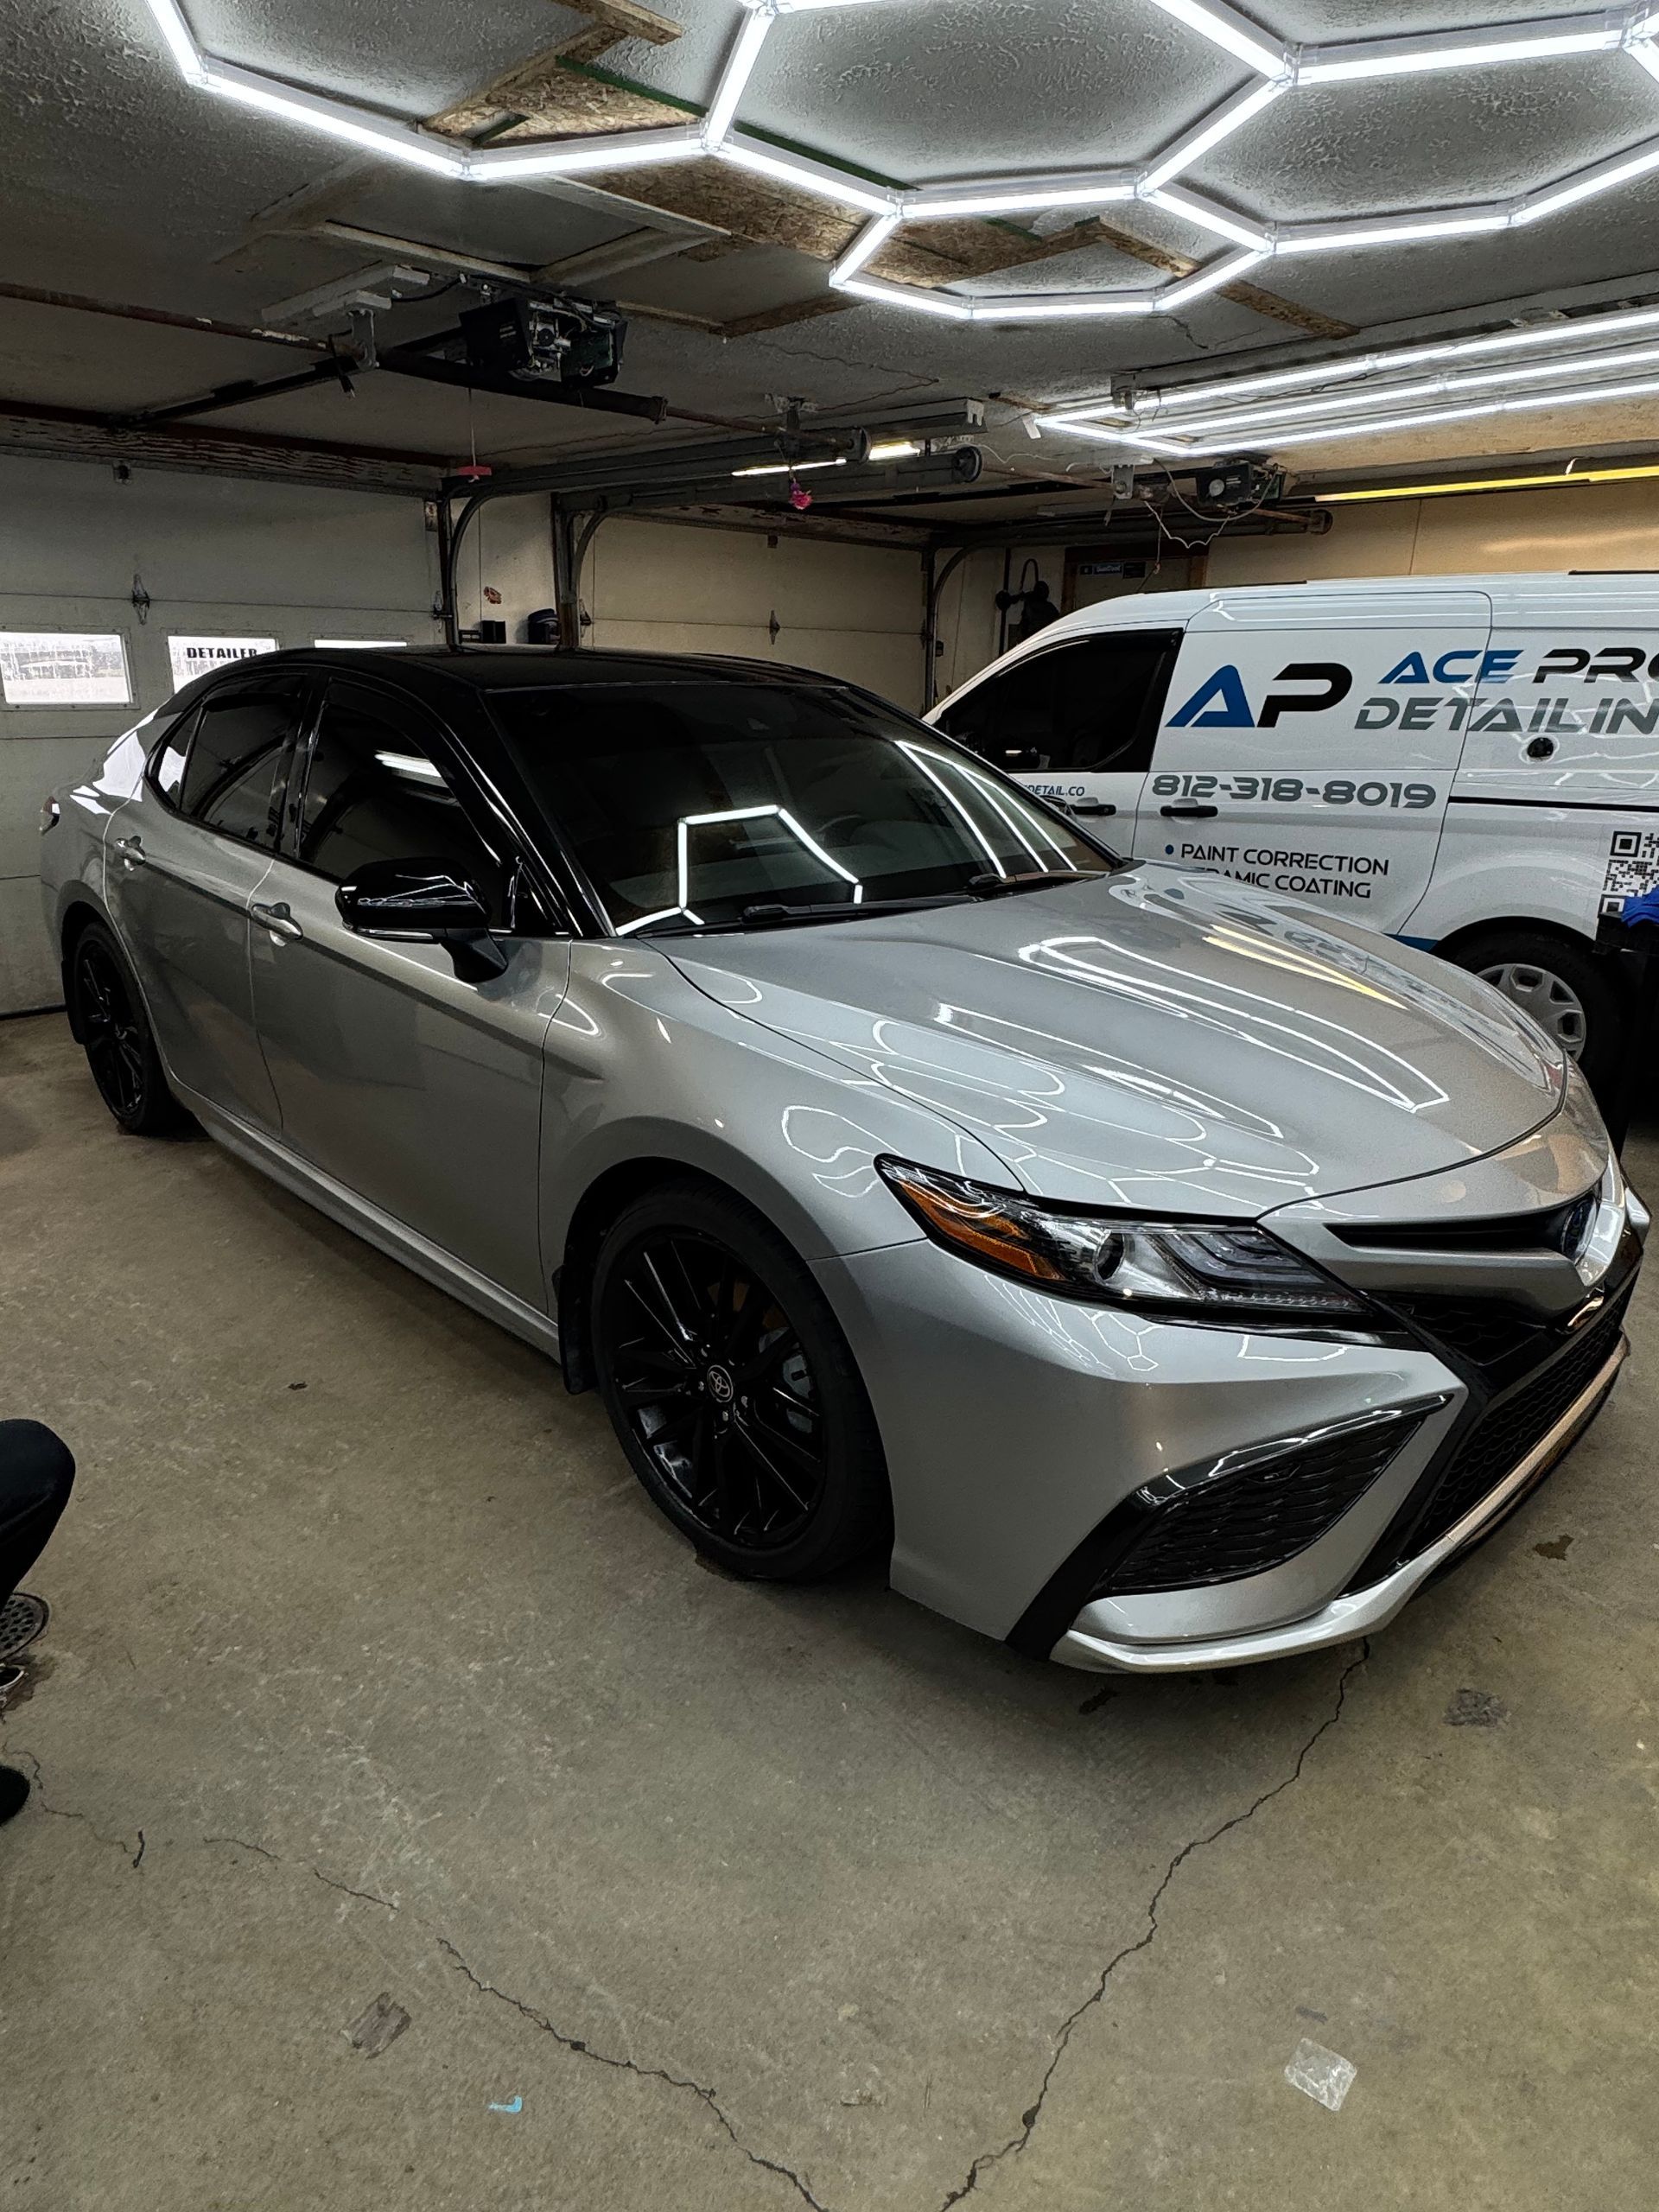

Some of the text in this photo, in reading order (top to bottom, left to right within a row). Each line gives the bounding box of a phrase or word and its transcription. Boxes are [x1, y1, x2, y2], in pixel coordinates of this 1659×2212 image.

[186, 647, 257, 658] DETAILER
[1377, 647, 1659, 684] ACE PR
[1164, 662, 1353, 728] AP
[1024, 784, 1085, 797] DETAIL.CO
[1152, 774, 1437, 809] 812-318-8019
[1180, 843, 1389, 875] PAINT CORRECTION
[1274, 874, 1371, 899] COATING
